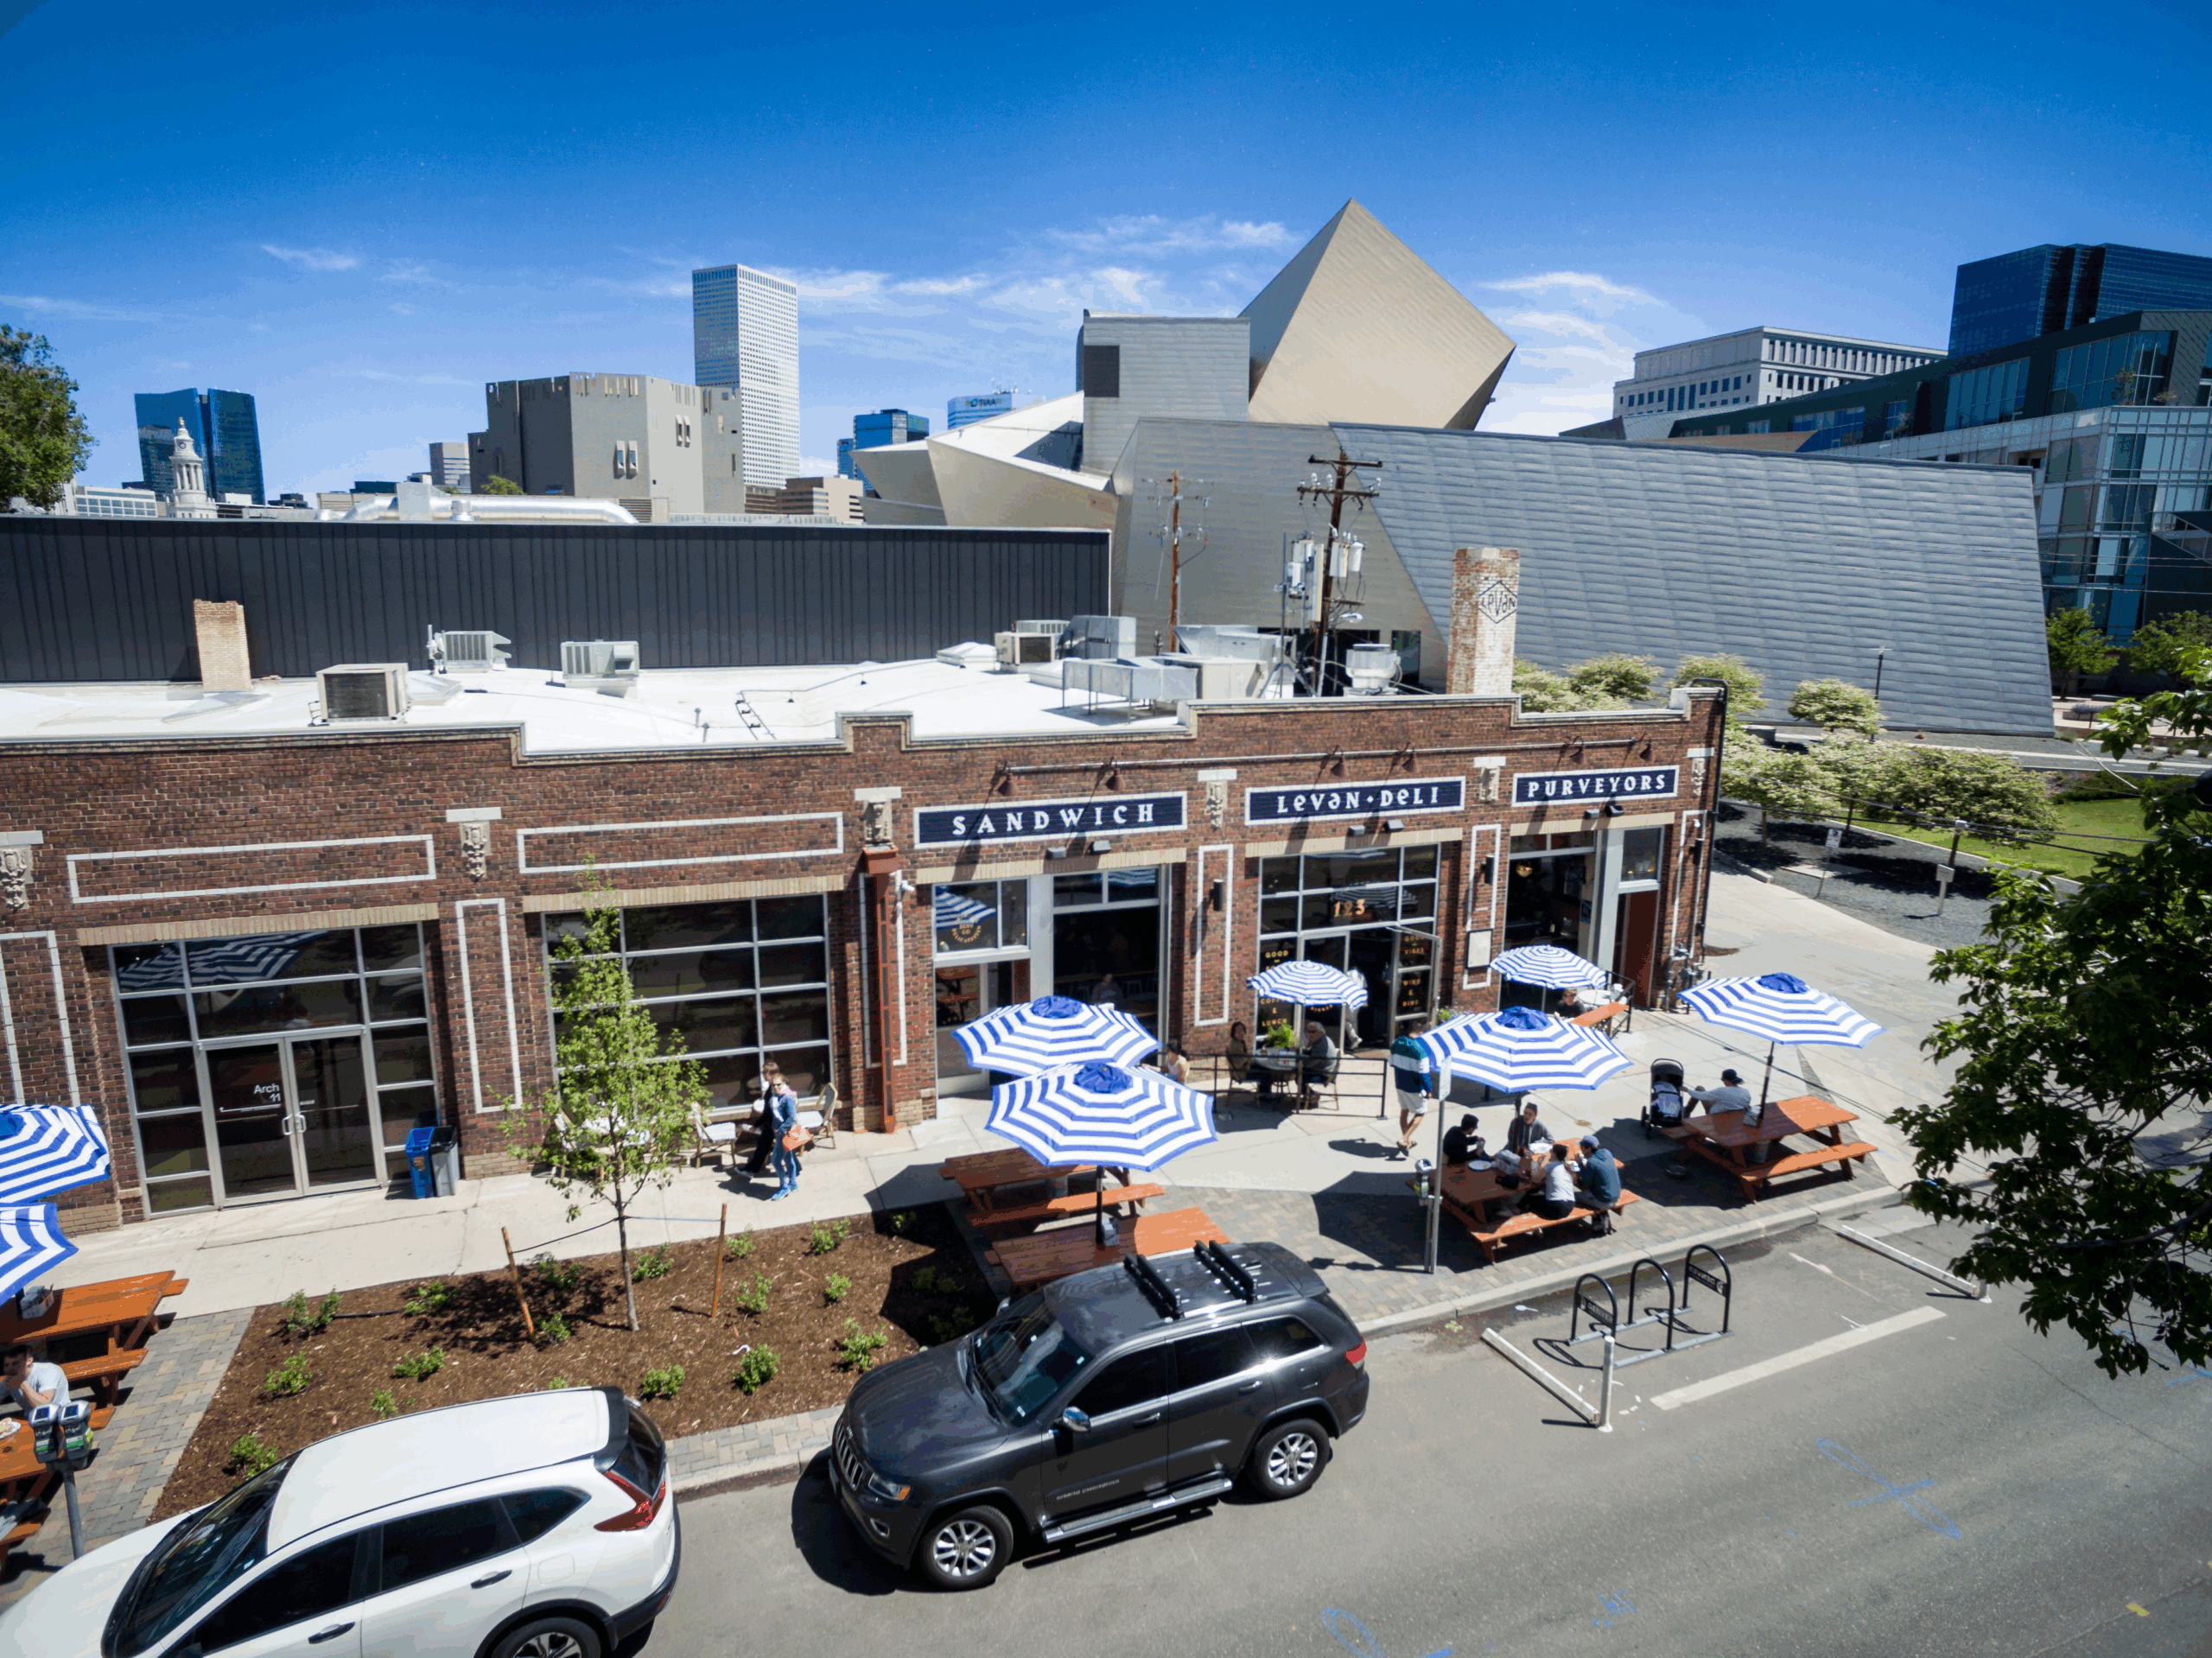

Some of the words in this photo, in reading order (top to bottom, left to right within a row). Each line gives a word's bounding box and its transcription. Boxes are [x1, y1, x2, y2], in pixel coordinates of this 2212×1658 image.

[1528, 774, 1666, 797] PURVEYORS
[952, 804, 1154, 835] SANDWICH
[1334, 899, 1366, 918] 123
[1262, 1018, 1287, 1026] LUNCH
[253, 1083, 280, 1094] Arch
[270, 1093, 281, 1102] 11
